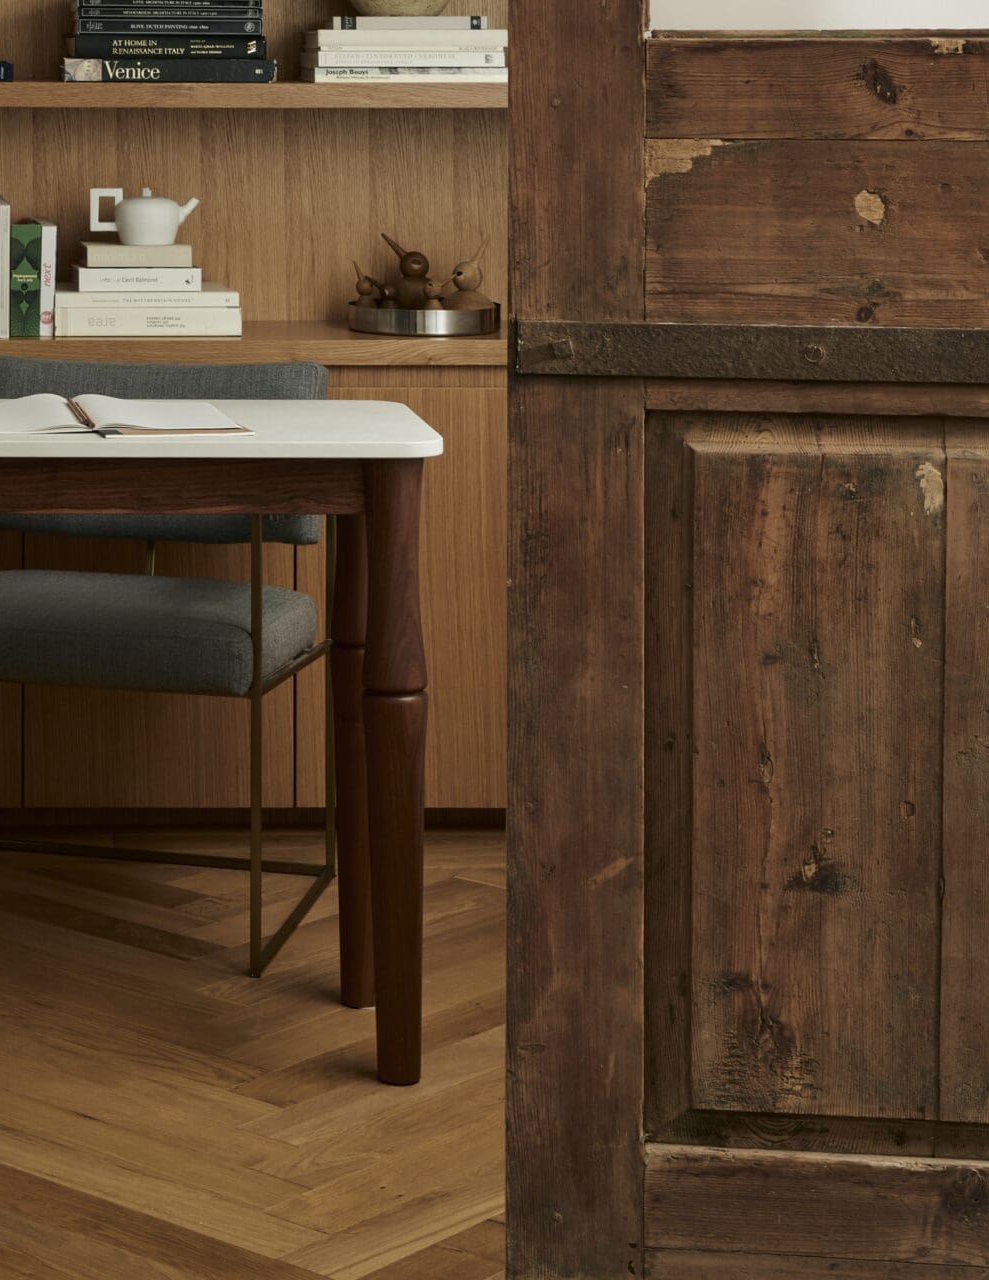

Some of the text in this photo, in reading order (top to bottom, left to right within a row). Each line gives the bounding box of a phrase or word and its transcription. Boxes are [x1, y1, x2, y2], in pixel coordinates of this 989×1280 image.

[112, 39, 158, 47] AT HOME IN
[112, 47, 186, 55] RENAISSANCE ITALY
[104, 59, 161, 80] Venice
[349, 69, 369, 77] Beuys
[43, 263, 52, 287] next
[87, 317, 116, 327] area
